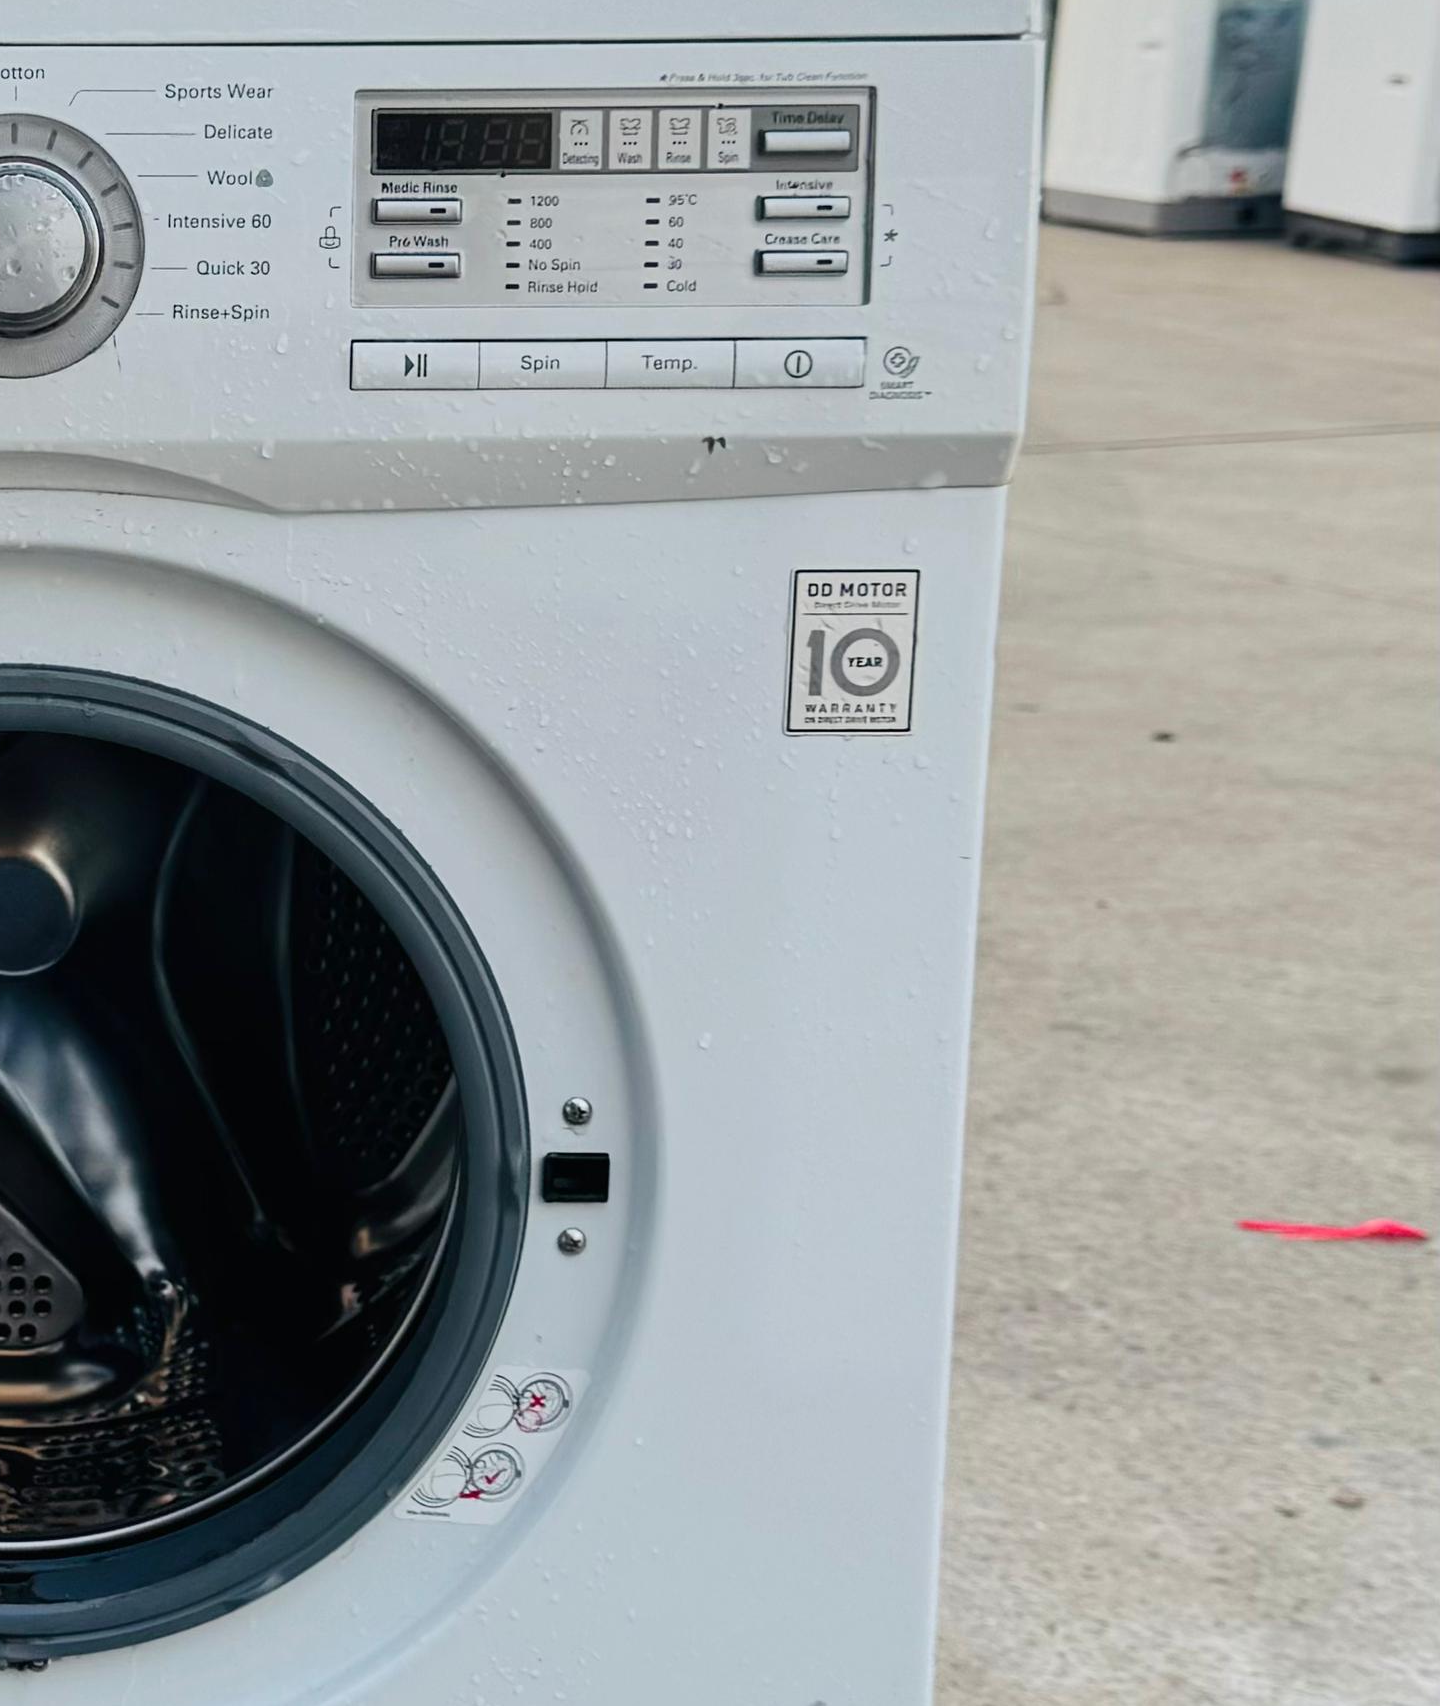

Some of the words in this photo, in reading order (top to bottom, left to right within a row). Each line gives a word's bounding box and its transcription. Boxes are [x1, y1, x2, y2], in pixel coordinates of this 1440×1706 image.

[165, 83, 222, 102] Sports
[227, 83, 274, 99] Wear
[771, 111, 804, 125] Time
[807, 110, 845, 126] Delay
[203, 124, 273, 139] Delicate
[562, 153, 599, 166] Detecting
[617, 152, 643, 164] Wash
[666, 152, 692, 164] Rinse
[718, 151, 739, 165] Spin
[207, 170, 253, 186] Wool
[381, 182, 420, 194] Medic
[423, 182, 458, 194] Rinse
[775, 180, 834, 191] Intensive
[530, 195, 560, 207] 1200
[167, 213, 246, 229] Intensive
[251, 214, 272, 229] 60
[529, 217, 553, 229] 800
[668, 217, 684, 228] 60
[413, 236, 449, 248] Wash
[529, 239, 552, 250] 400
[667, 238, 684, 249] 40
[764, 233, 808, 245] Crease
[810, 233, 841, 245] Care
[196, 260, 245, 276] Quick
[250, 261, 271, 276] 30
[528, 259, 549, 272] No
[551, 258, 581, 273] Spin
[667, 258, 682, 270] 30
[527, 281, 564, 293] Rinse
[567, 281, 598, 293] Hold
[666, 280, 697, 292] Cold
[172, 304, 270, 322] Rinse+Spin
[520, 355, 561, 373] Spin
[641, 355, 698, 373] Temp.
[808, 583, 832, 597] DD
[840, 582, 907, 597] MOTOR
[847, 657, 883, 668] YEAR
[804, 703, 897, 713] WARRANTY
